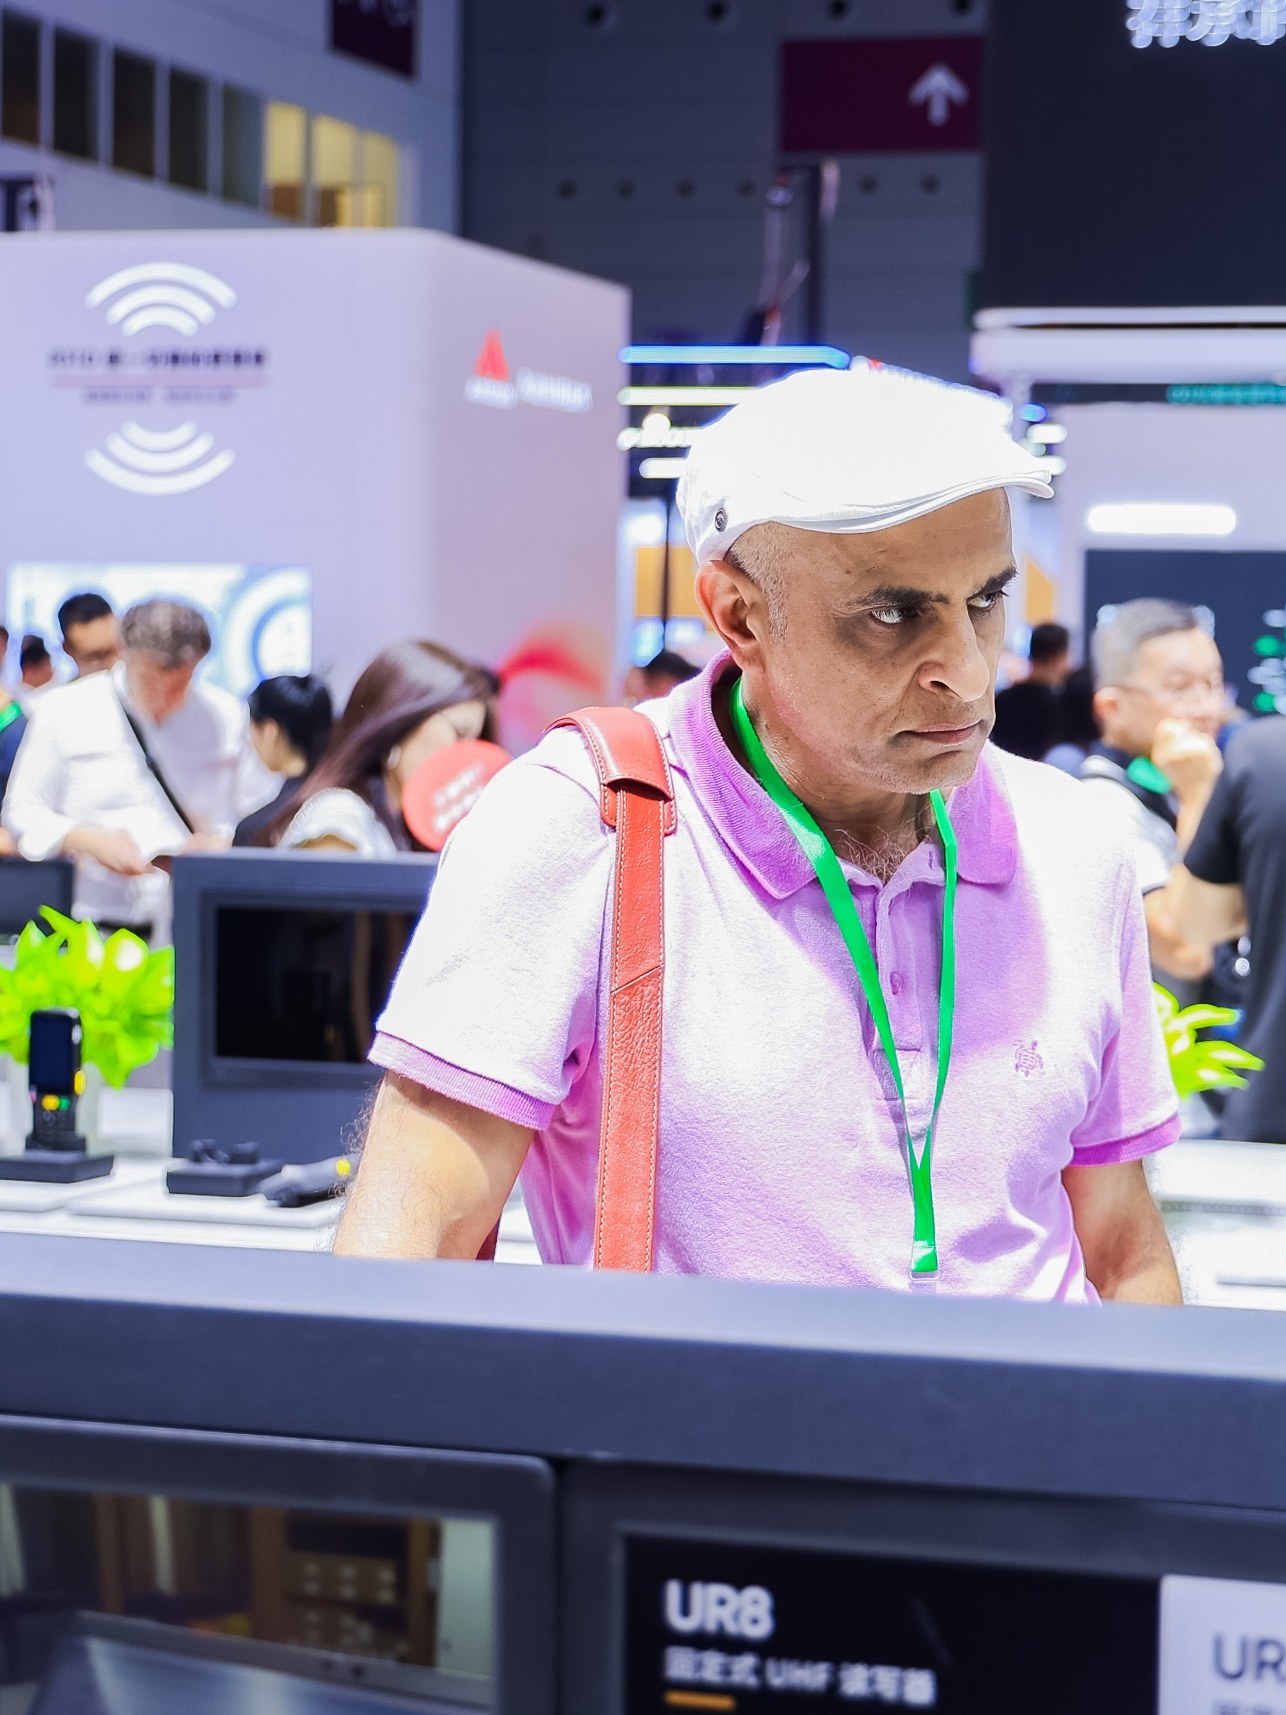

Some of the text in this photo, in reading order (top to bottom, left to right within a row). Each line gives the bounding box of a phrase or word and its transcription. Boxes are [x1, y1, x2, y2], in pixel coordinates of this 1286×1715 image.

[665, 1578, 774, 1639] UR8
[665, 1645, 760, 1688] 固定式
[764, 1656, 832, 1692] UHF
